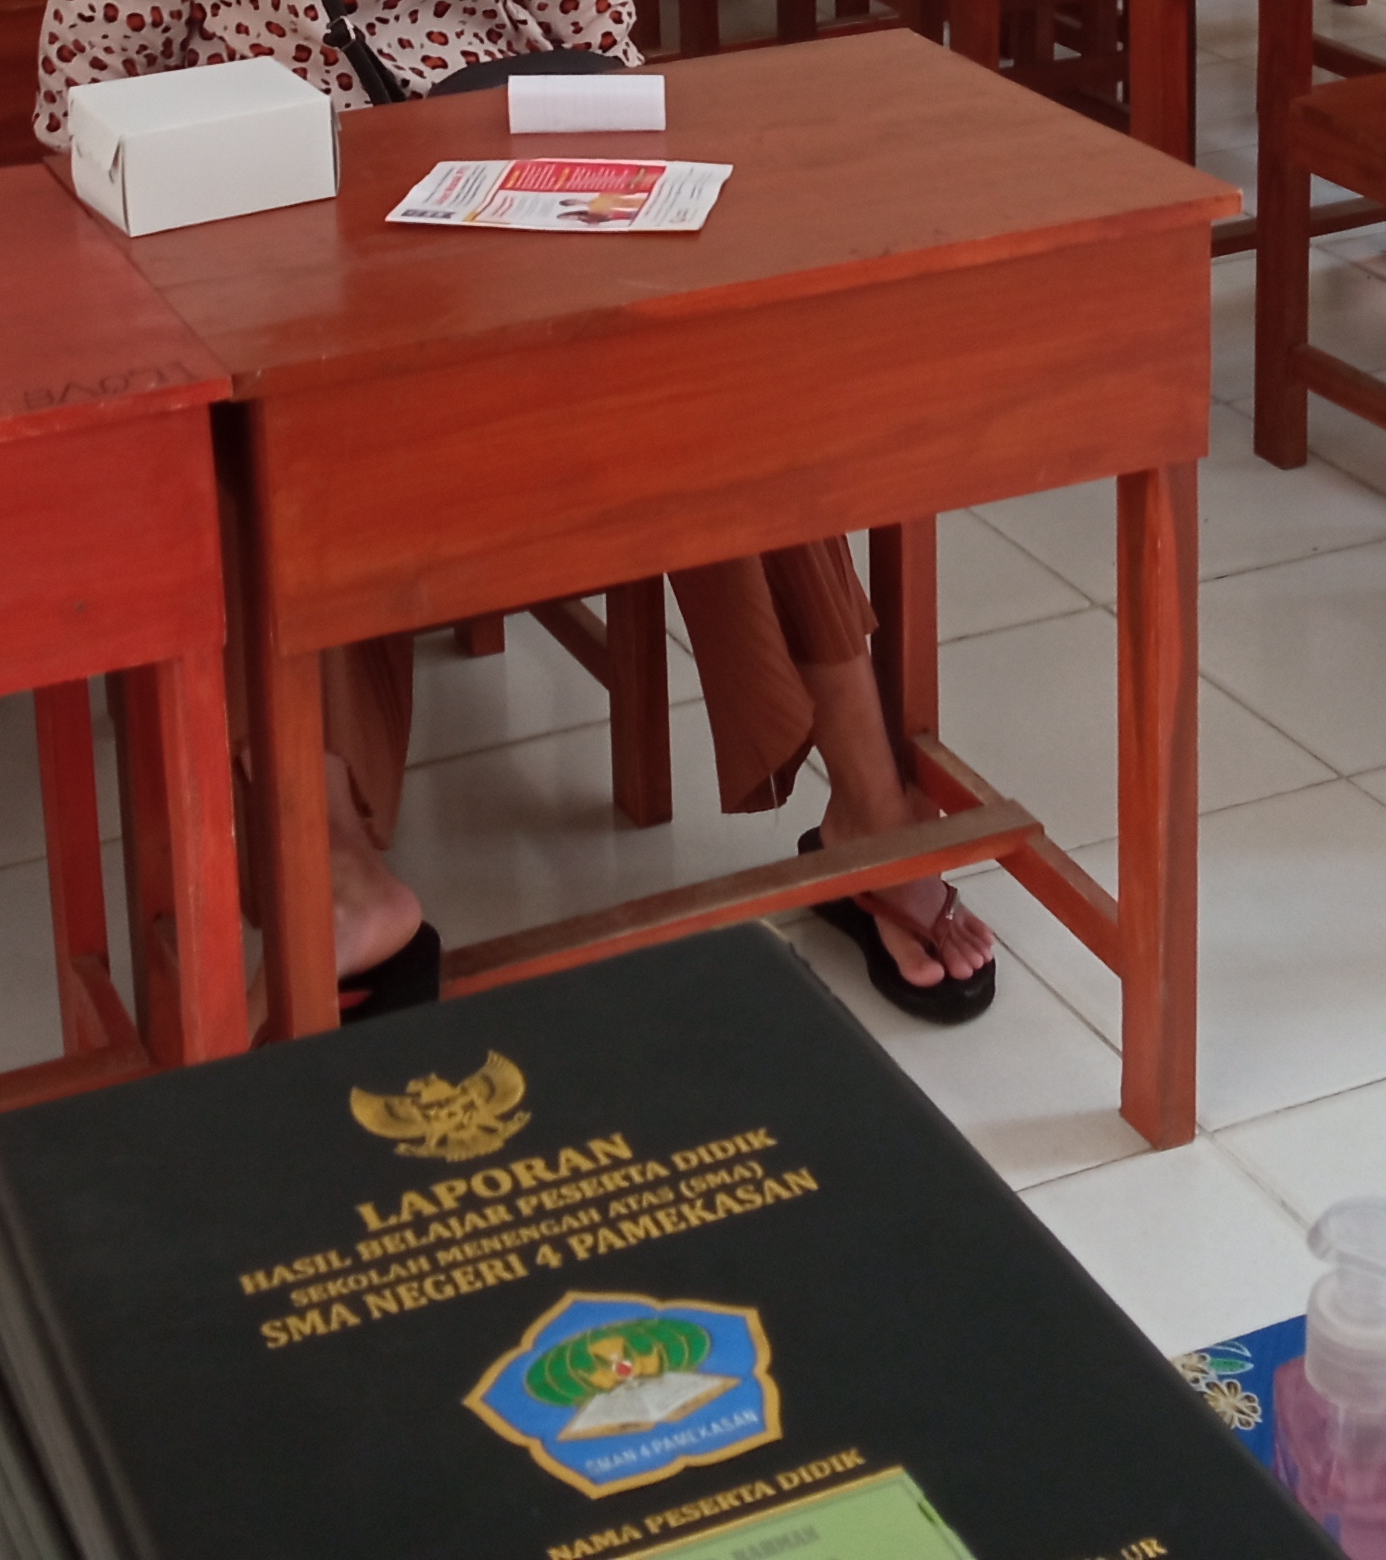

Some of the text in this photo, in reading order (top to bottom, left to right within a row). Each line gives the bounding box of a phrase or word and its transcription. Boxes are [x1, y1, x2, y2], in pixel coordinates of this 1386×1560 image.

[239, 1127, 778, 1295] HASIL BELAJAR PESERTA DIDIK
[289, 1160, 764, 1308] SEKOLAH MENENGAH ATAS (SMA)
[355, 1132, 633, 1232] LAPORAN
[260, 1166, 819, 1349] SMA NEGERI 4 PAMEKASAN
[547, 1447, 867, 1560] NAMA PESERTA DIDIK
[584, 1448, 637, 1475] SMAN
[650, 1408, 759, 1455] PAMEKASAN
